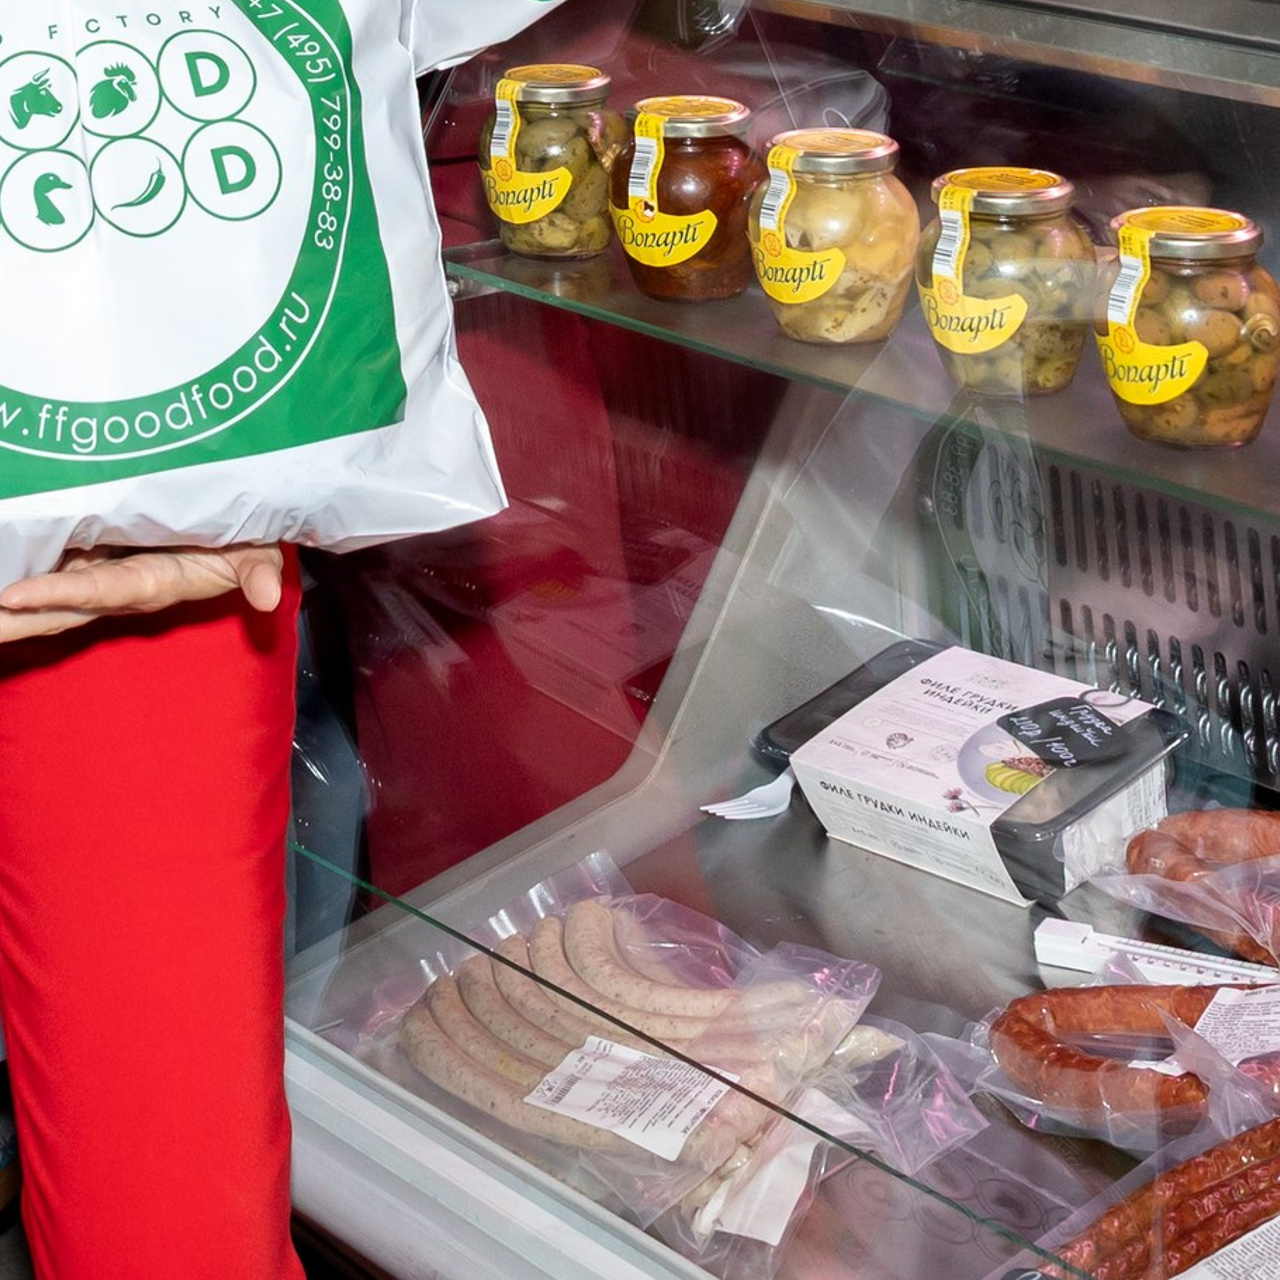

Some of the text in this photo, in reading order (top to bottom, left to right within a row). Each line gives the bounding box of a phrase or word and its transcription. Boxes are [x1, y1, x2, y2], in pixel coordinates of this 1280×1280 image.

[48, 5, 221, 40] FCTORY
[273, 22, 337, 83] (495)
[314, 95, 344, 251] 799-38-83
[920, 677, 963, 693] ФИЛЕ
[962, 689, 1019, 712] ГРУДКИ
[923, 689, 993, 715] ИНДЕЙКИ
[820, 780, 970, 840] ФИЛЕ ГРУДКИ ИНДЕЙКИ
